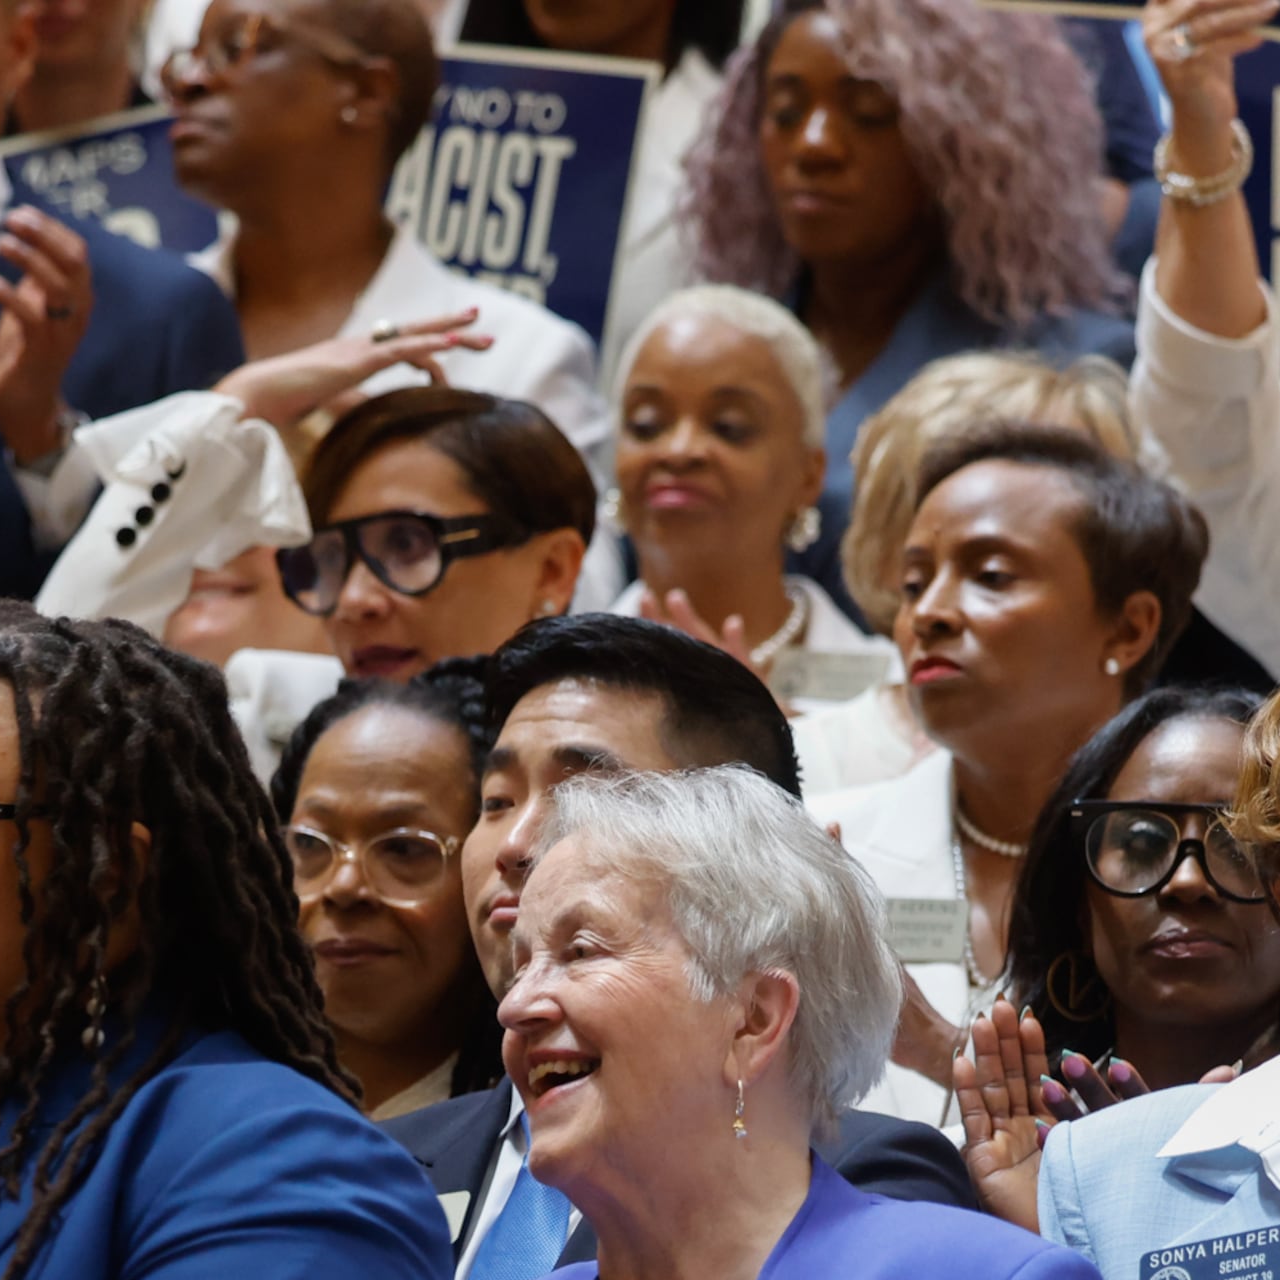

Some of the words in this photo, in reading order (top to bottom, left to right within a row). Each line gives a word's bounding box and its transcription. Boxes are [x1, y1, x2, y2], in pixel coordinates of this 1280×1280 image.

[448, 87, 512, 129] NO
[514, 90, 568, 134] TO
[384, 124, 577, 288] ACIST,
[1149, 1244, 1207, 1268] SONYA
[1219, 1253, 1266, 1274] SENATOR
